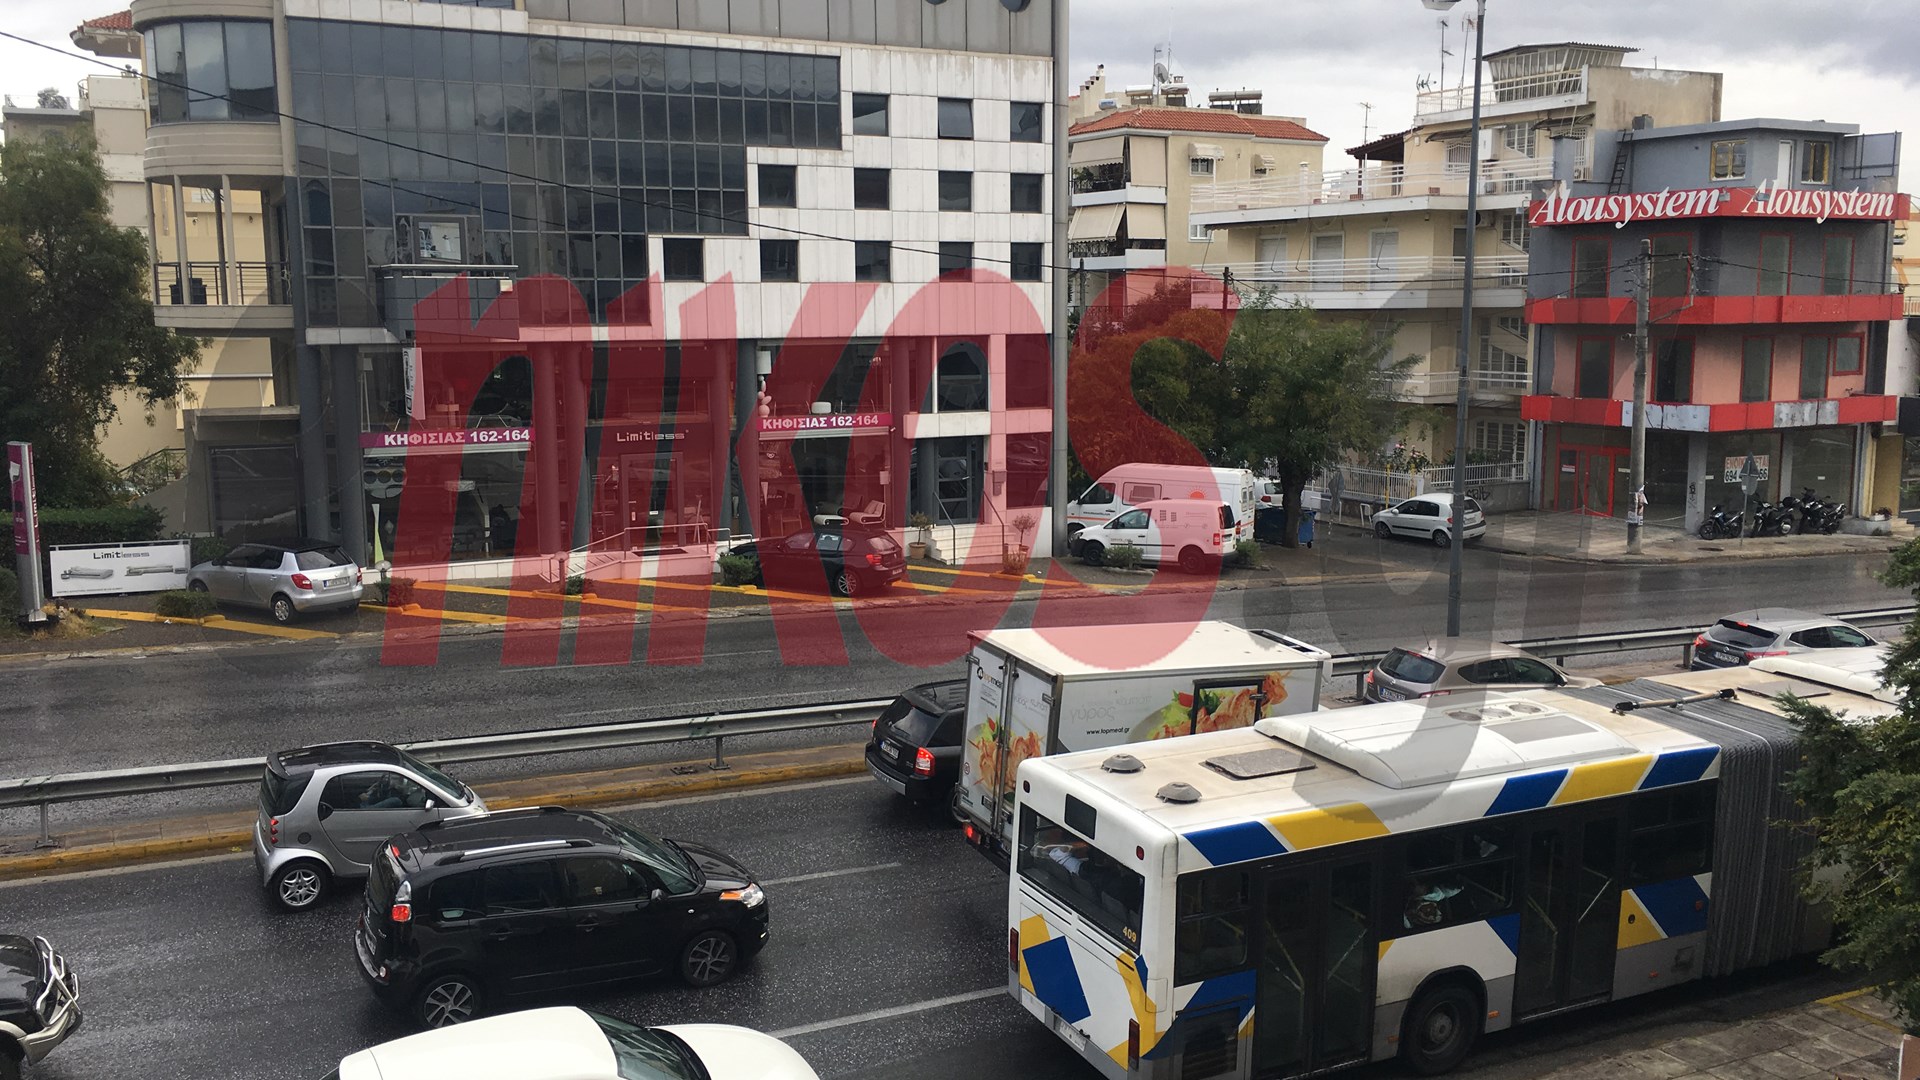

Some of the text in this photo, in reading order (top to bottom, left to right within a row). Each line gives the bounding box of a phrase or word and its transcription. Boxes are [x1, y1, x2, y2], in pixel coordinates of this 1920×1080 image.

[1529, 186, 1720, 229] Alousystem
[1741, 178, 1894, 224] Alousystem
[762, 415, 879, 430] ΚΗΦΙΣΙΑΣ 162-164
[384, 429, 530, 446] ΚΗΦΙΣΙΑΣ 162-164
[616, 431, 685, 442] Limitless
[1086, 726, 1130, 736] www.topmeat.gr
[1122, 926, 1137, 943] 409
